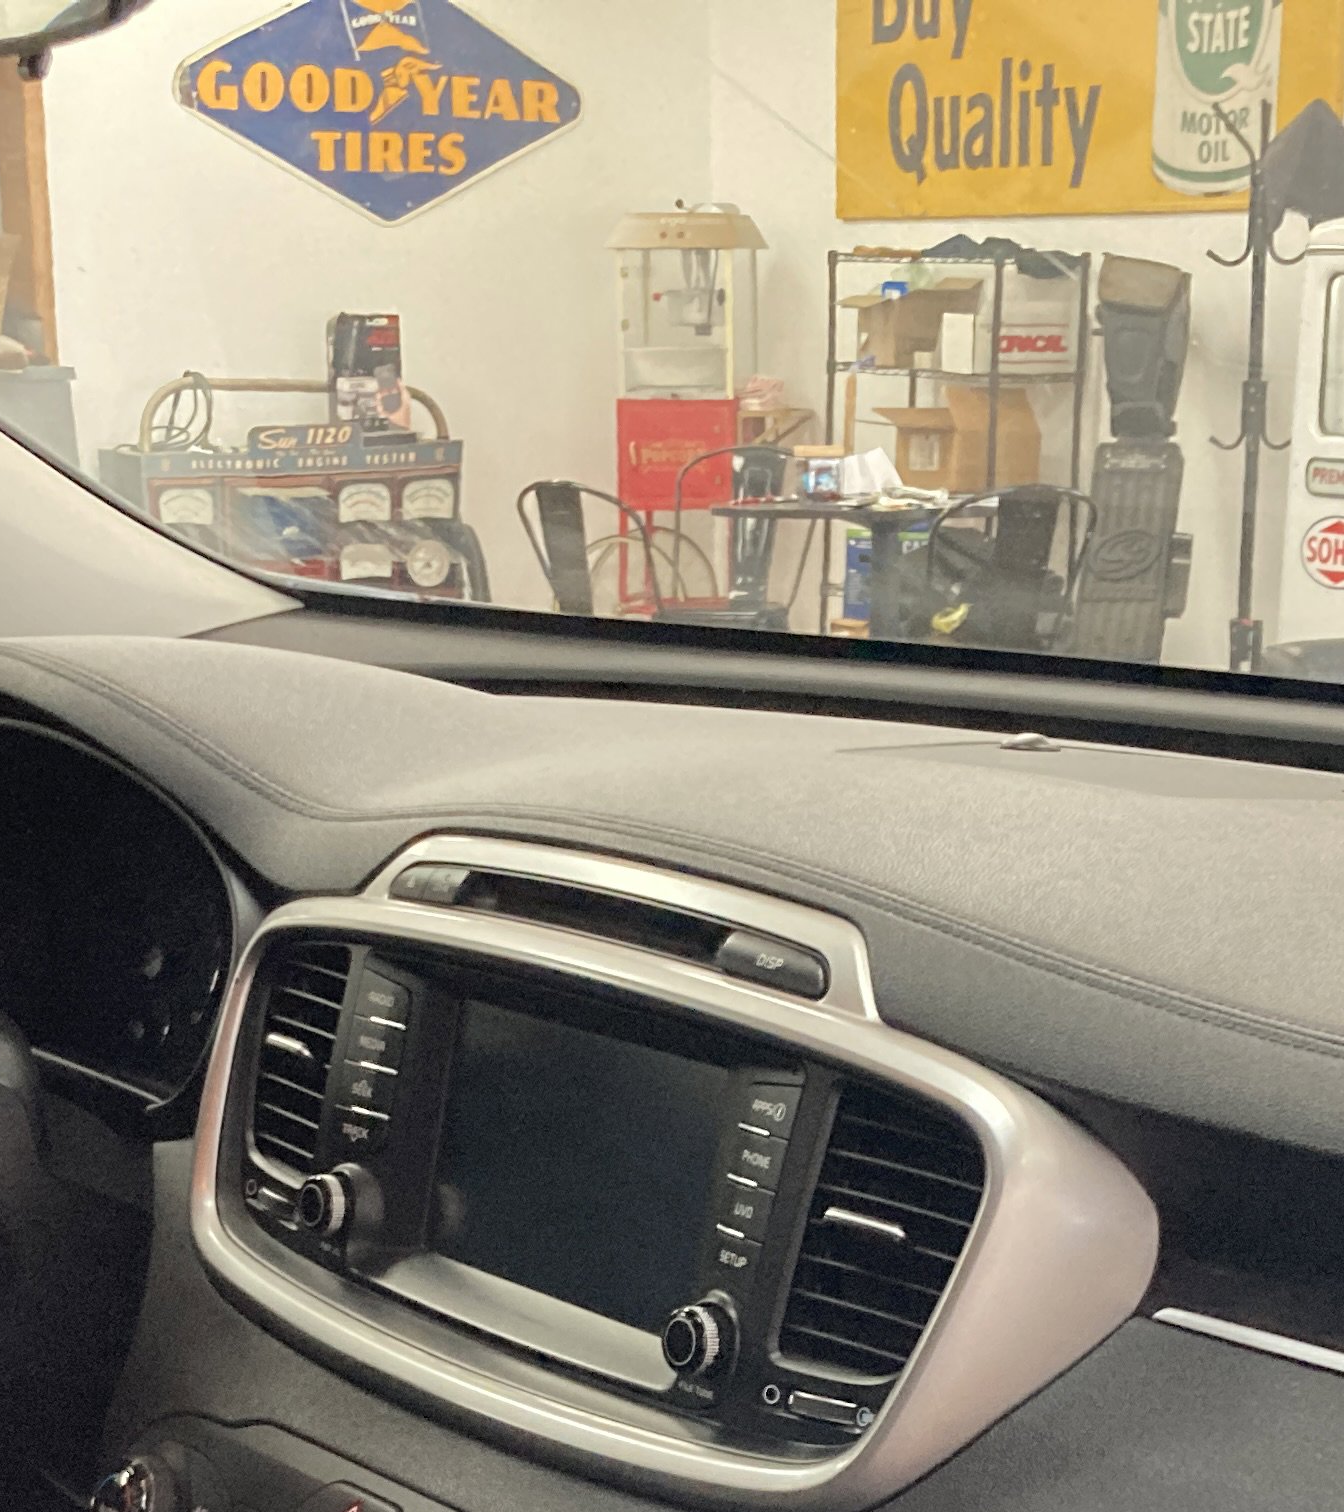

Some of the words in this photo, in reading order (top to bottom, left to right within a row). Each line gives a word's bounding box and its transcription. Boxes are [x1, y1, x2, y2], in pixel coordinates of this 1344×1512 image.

[1186, 5, 1251, 54] STATE
[887, 56, 1103, 189] Quality
[310, 130, 468, 176] TIRES
[1197, 139, 1231, 165] OIL
[306, 426, 353, 445] 1120
